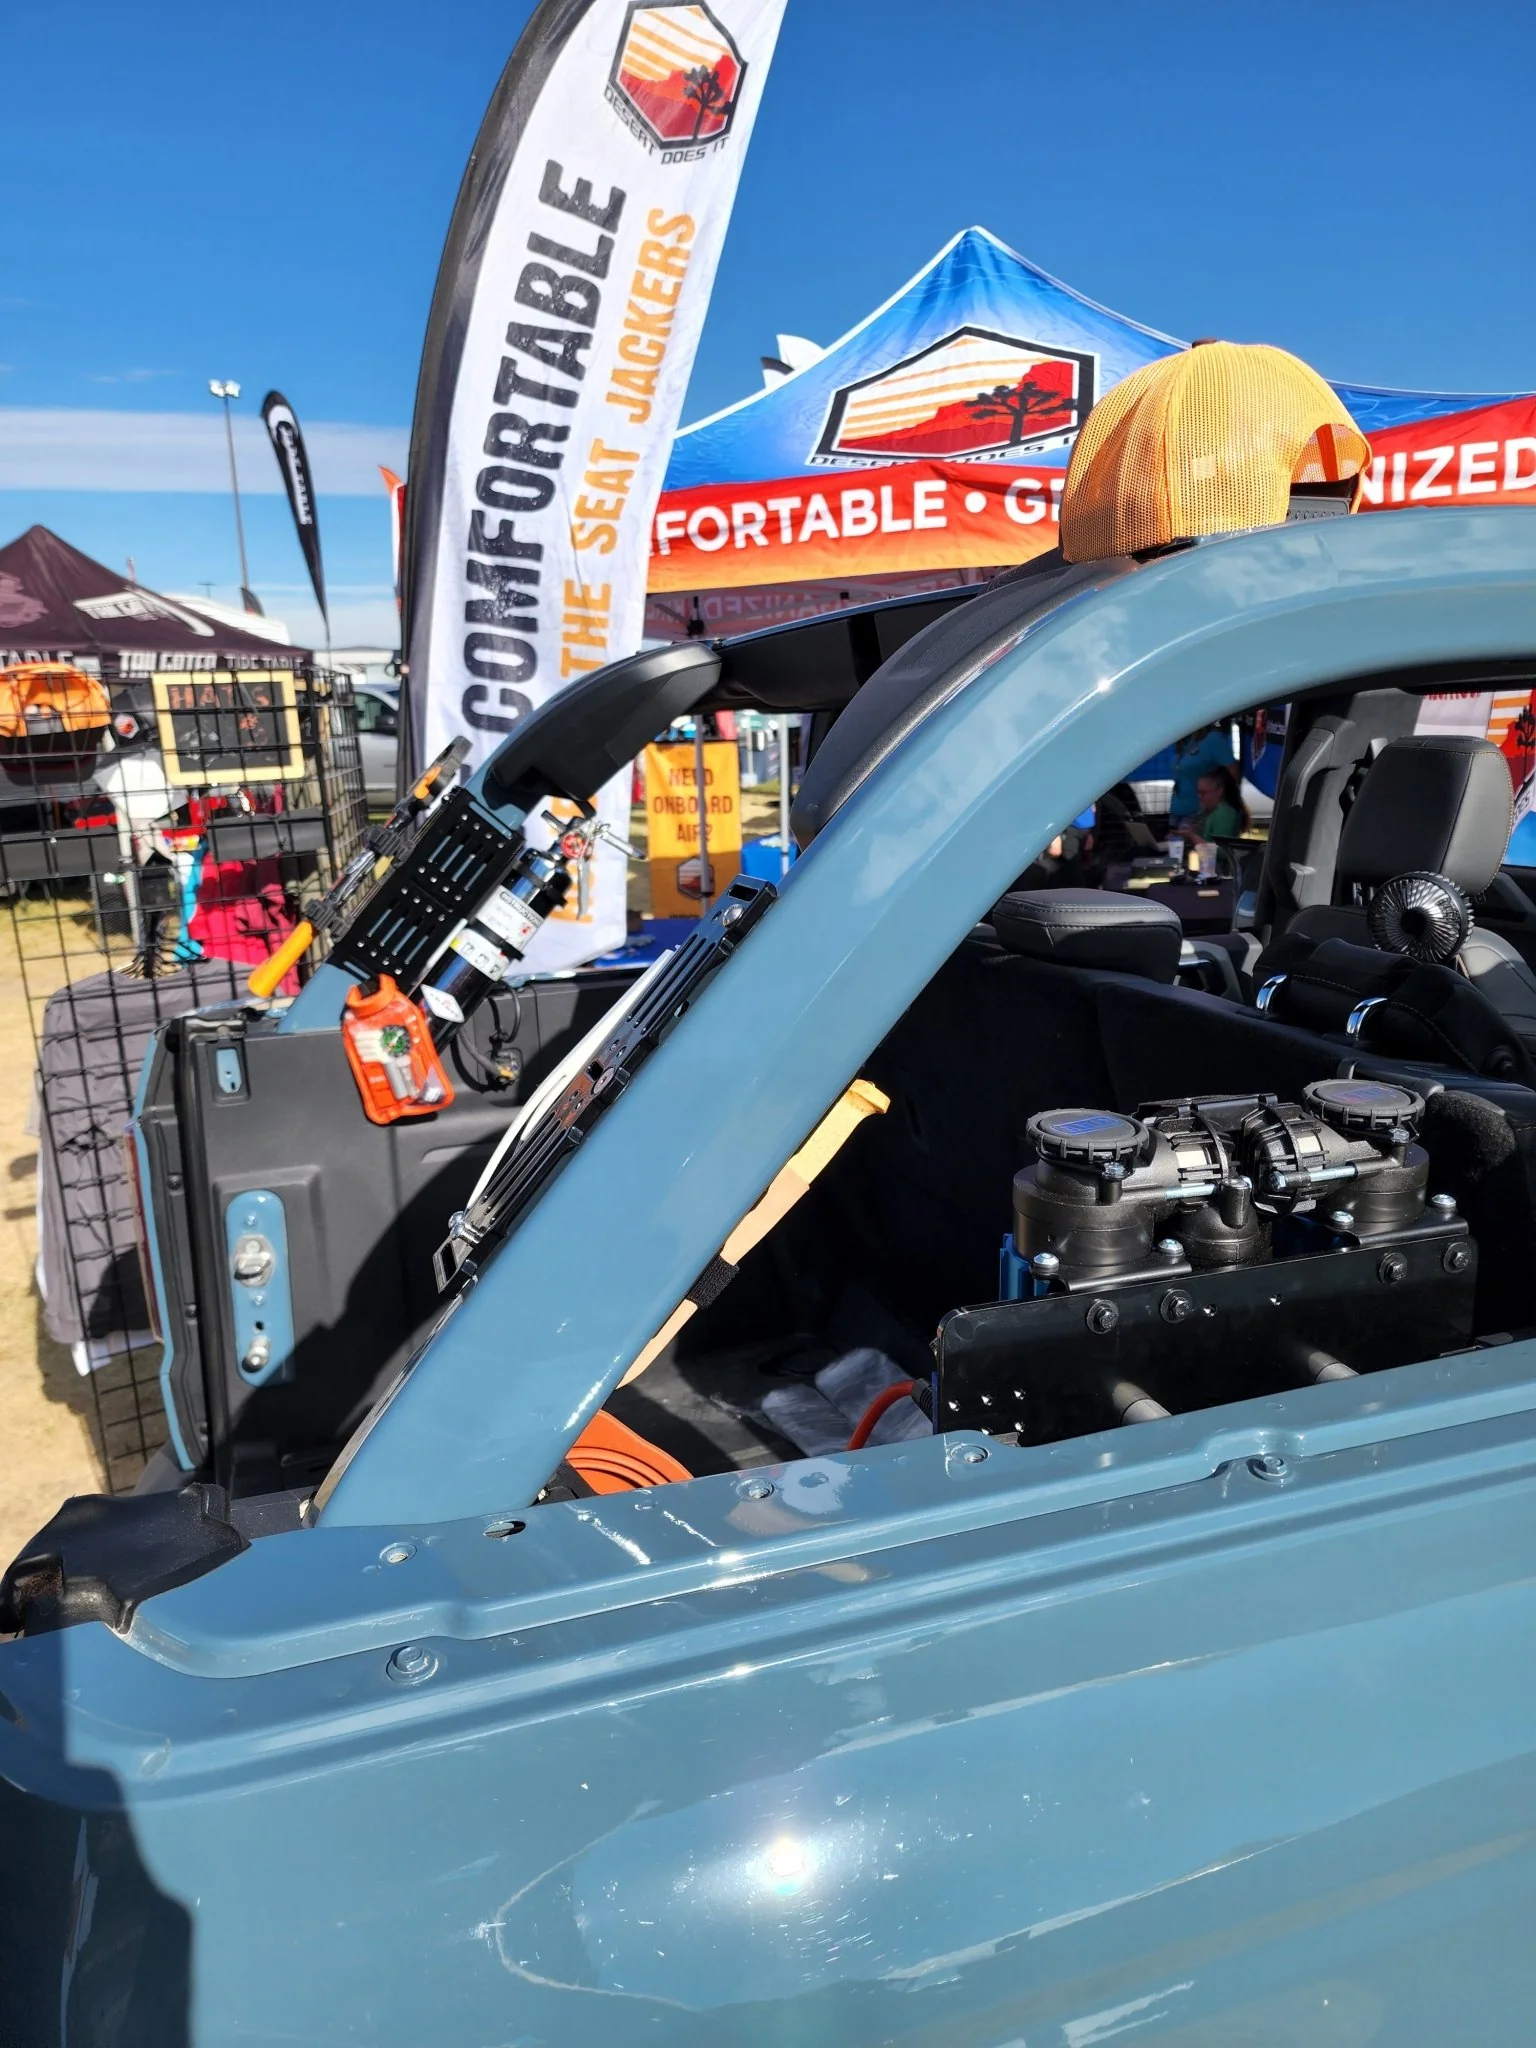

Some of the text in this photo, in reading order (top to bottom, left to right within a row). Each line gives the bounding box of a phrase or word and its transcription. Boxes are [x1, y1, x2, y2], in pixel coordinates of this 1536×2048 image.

[603, 86, 731, 165] DESERT DOES IT
[461, 159, 627, 734] COMFORTABLE
[560, 207, 697, 678] THE SEAT JACKERS
[649, 479, 947, 557] FORTABLE
[169, 685, 270, 708] HATS
